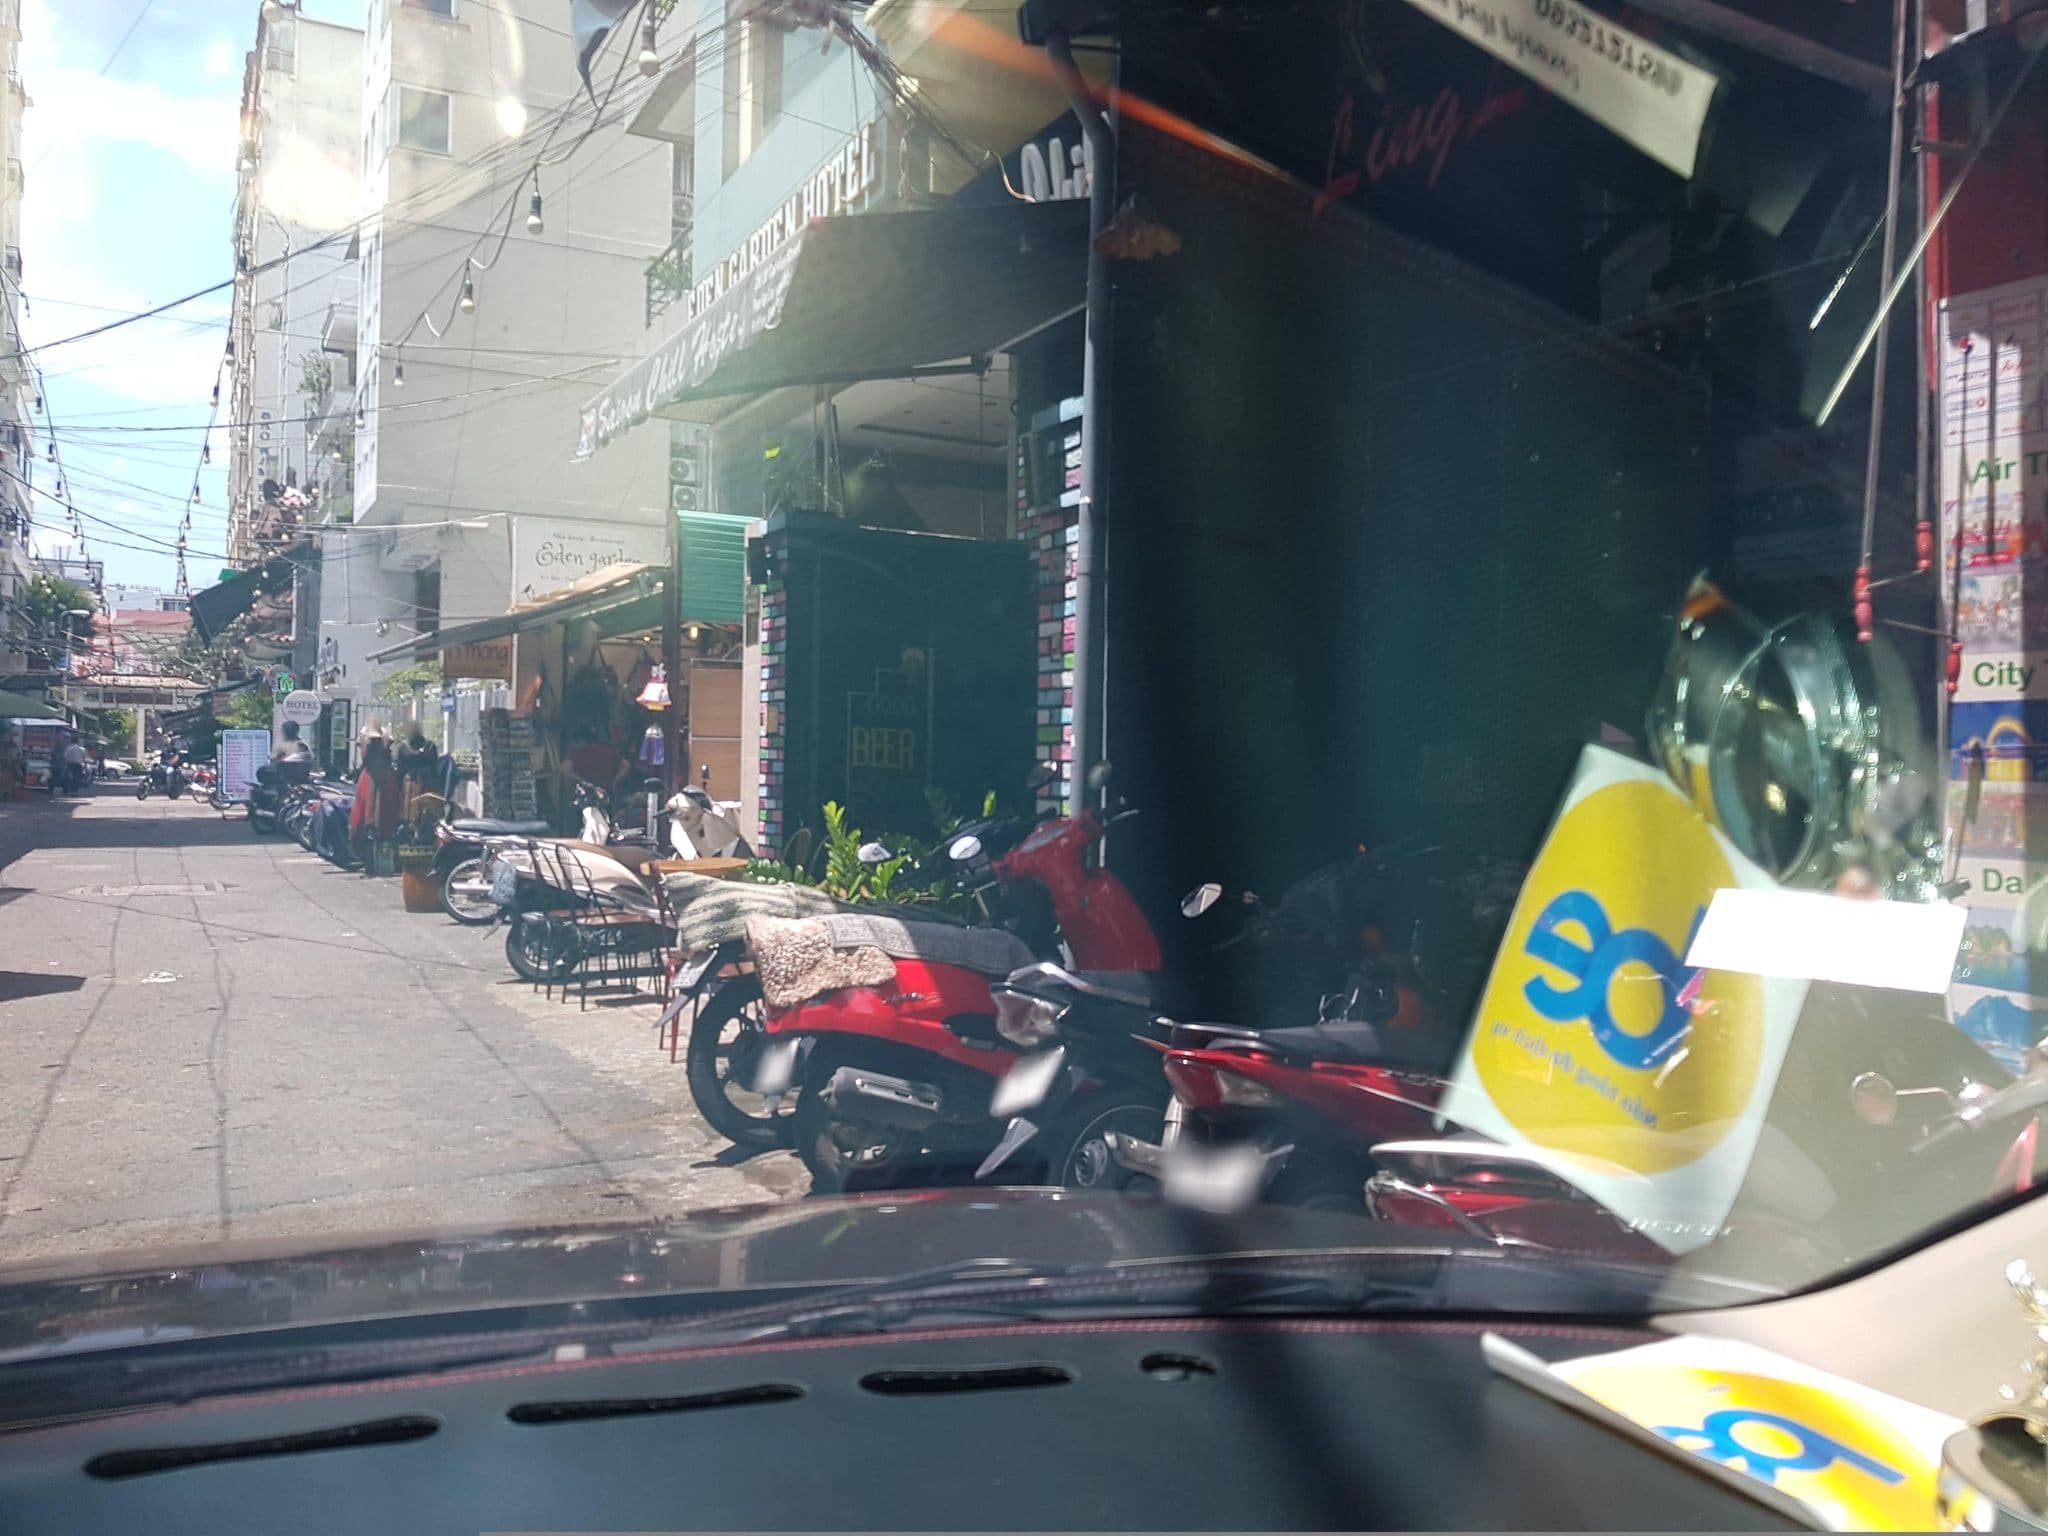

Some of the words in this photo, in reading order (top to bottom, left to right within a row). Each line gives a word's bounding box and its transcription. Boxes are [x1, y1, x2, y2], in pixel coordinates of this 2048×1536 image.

[802, 124, 876, 226] HOTEL
[1971, 457, 2018, 484] Air
[535, 541, 583, 567] Eden
[1973, 660, 2036, 692] City
[286, 700, 319, 710] HOTEL
[852, 726, 914, 769] BEER
